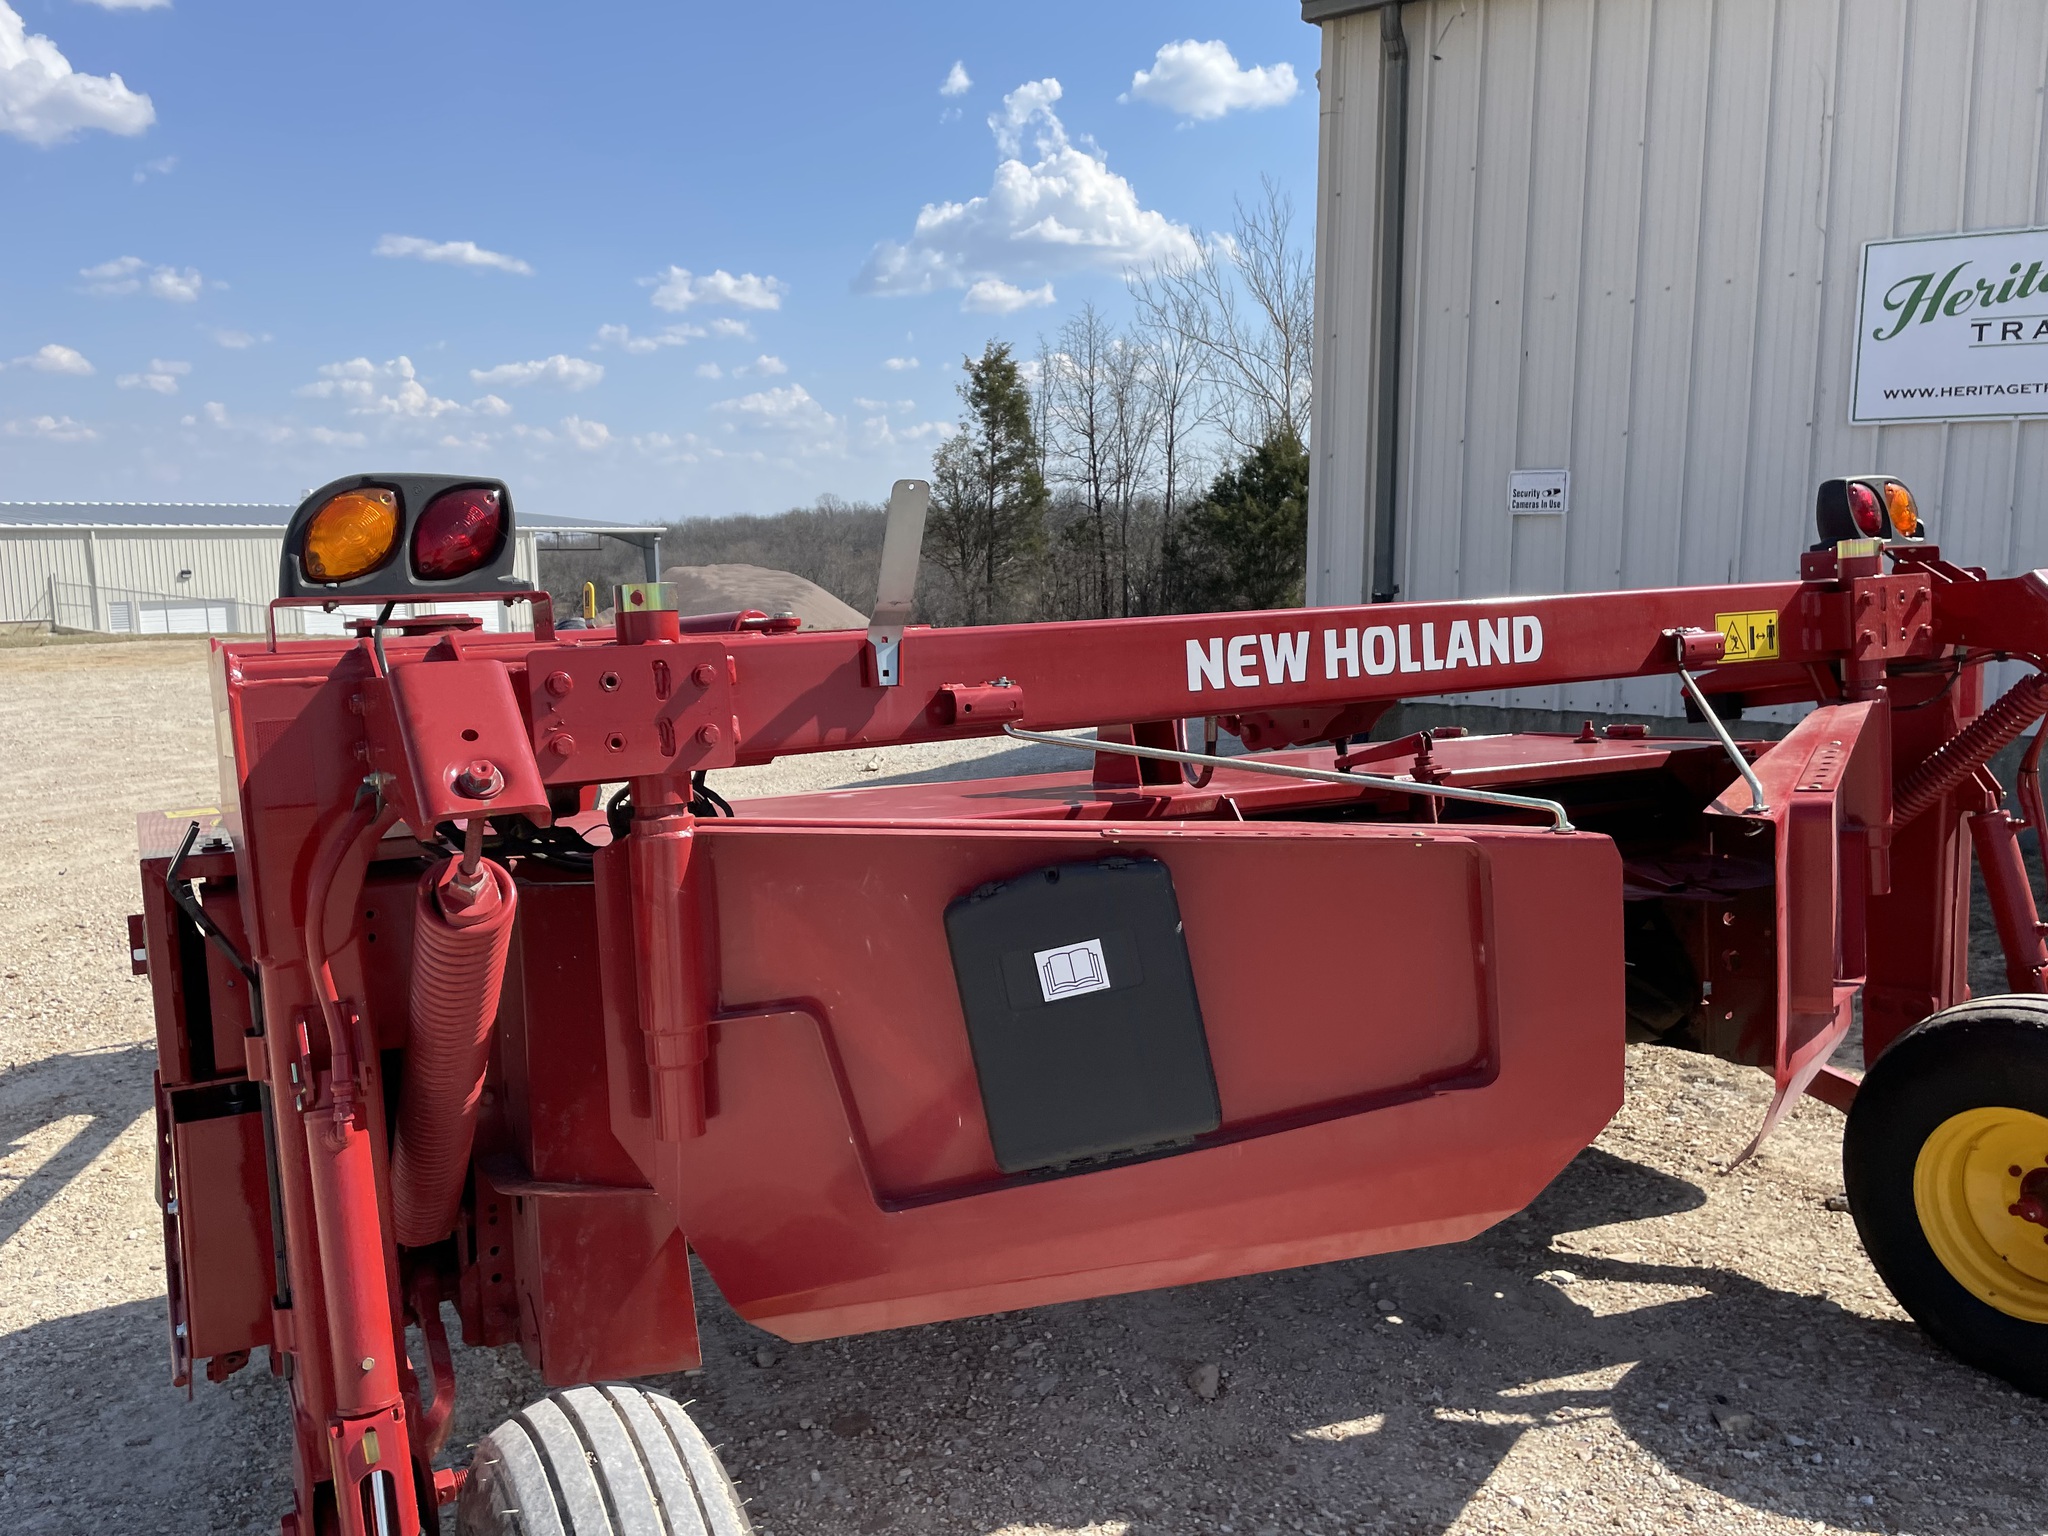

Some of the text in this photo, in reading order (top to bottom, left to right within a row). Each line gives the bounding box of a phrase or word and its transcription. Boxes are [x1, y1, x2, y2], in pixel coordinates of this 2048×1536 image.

[1512, 488, 1541, 500] Security
[1511, 499, 1561, 509] Cameras In Use
[1185, 615, 1544, 692] NEW HOLLAND
